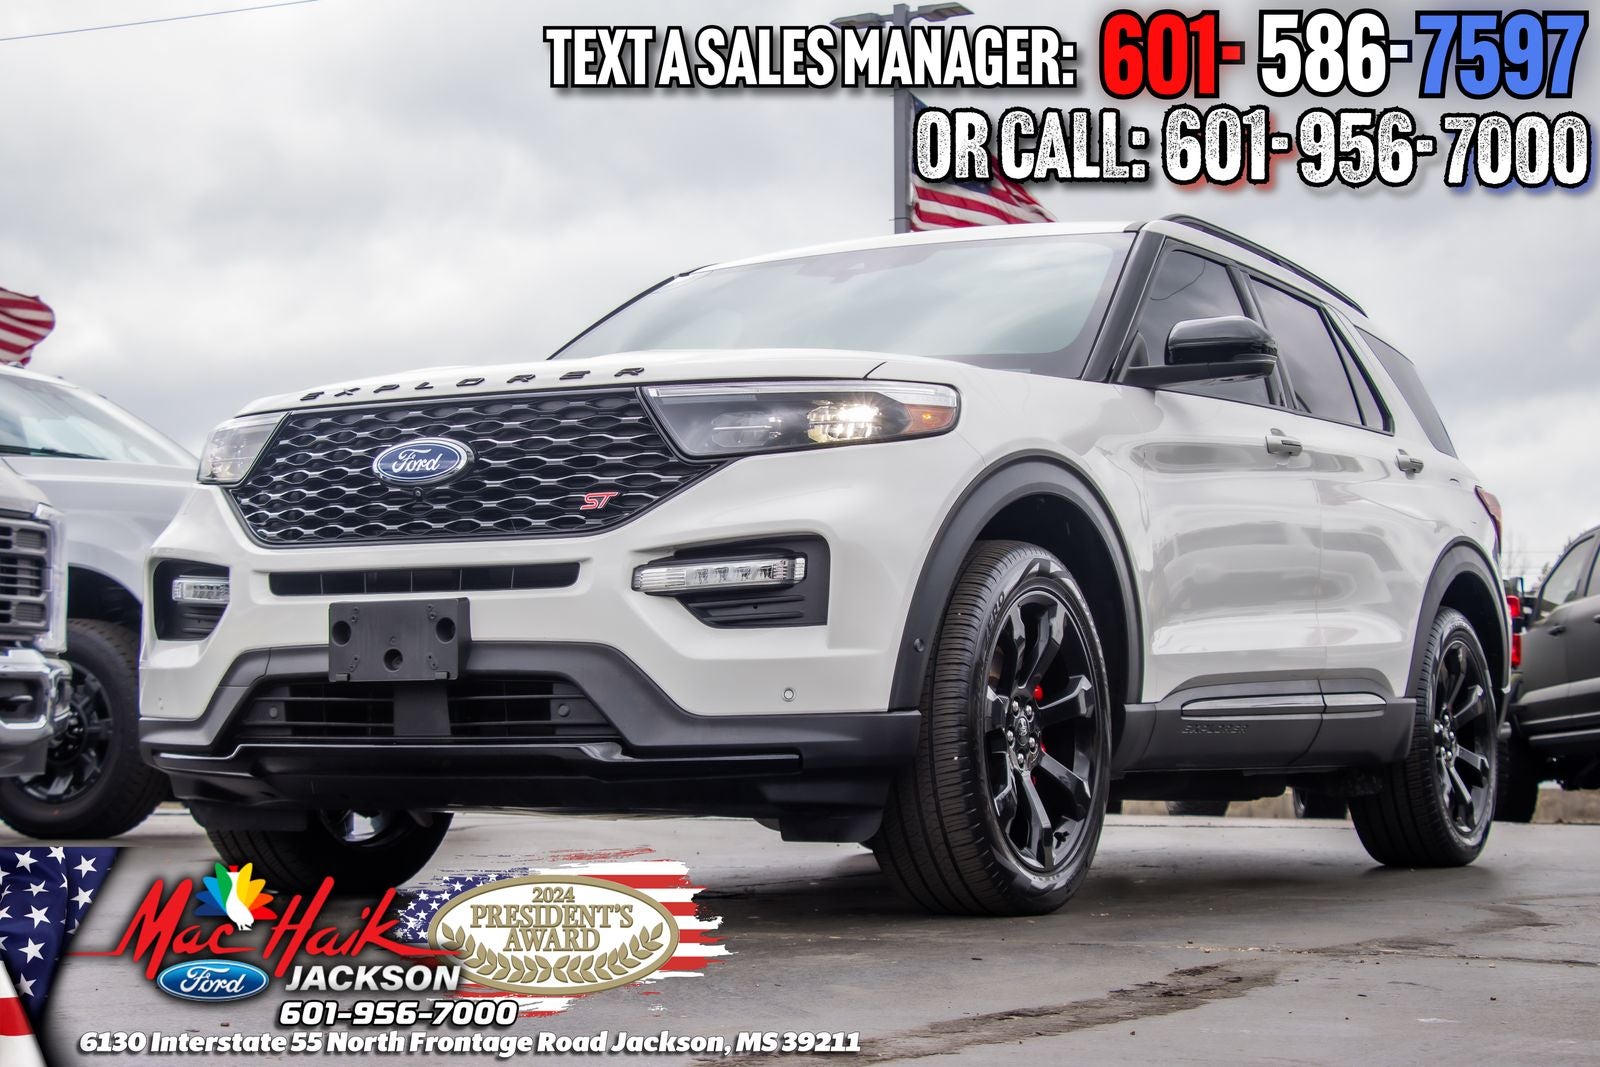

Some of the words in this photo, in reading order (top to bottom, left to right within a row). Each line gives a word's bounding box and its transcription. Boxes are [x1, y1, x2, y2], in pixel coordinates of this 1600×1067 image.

[300, 367, 645, 401] EXPLORER
[391, 447, 441, 474] Ford
[580, 491, 619, 510] ST
